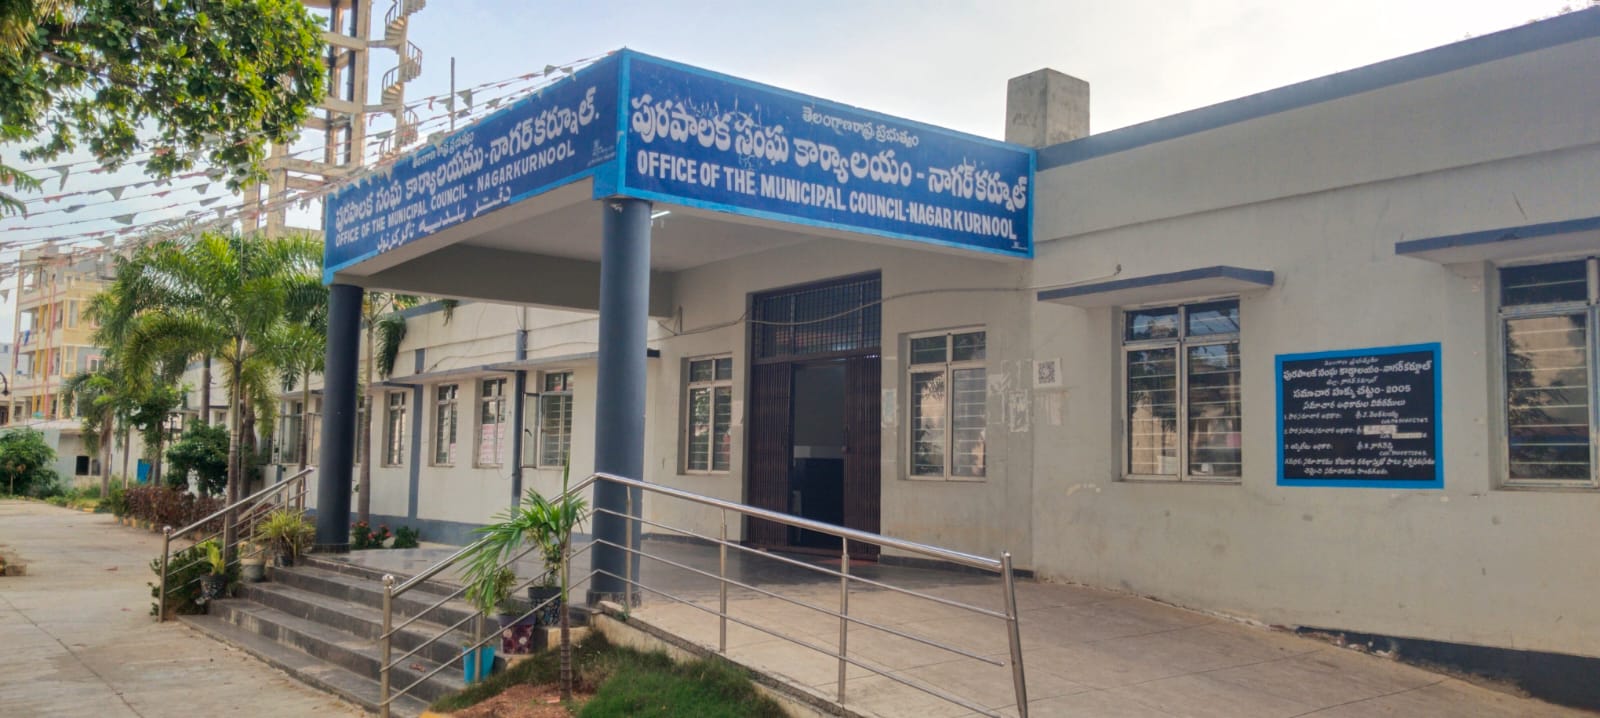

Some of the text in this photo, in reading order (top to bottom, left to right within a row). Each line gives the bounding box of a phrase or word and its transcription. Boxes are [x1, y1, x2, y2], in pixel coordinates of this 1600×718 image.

[632, 94, 731, 151] పురపాలక
[735, 115, 788, 166] సంఘ
[793, 138, 912, 187] కార్యాలయం
[336, 226, 359, 248] OFFICE
[362, 222, 371, 239] OF
[373, 216, 386, 233] THE
[388, 199, 428, 228] MUNICIPAL
[431, 183, 468, 211] COUNCIL
[477, 140, 575, 193] NAGARKURNOOL
[336, 191, 373, 233] పురపాలక
[376, 179, 402, 214] సంఘ
[637, 150, 697, 184] OFFICE
[700, 162, 720, 189] OF
[723, 166, 756, 196] THE
[760, 174, 847, 211] MUNICIPAL
[1386, 384, 1412, 394] 2005
